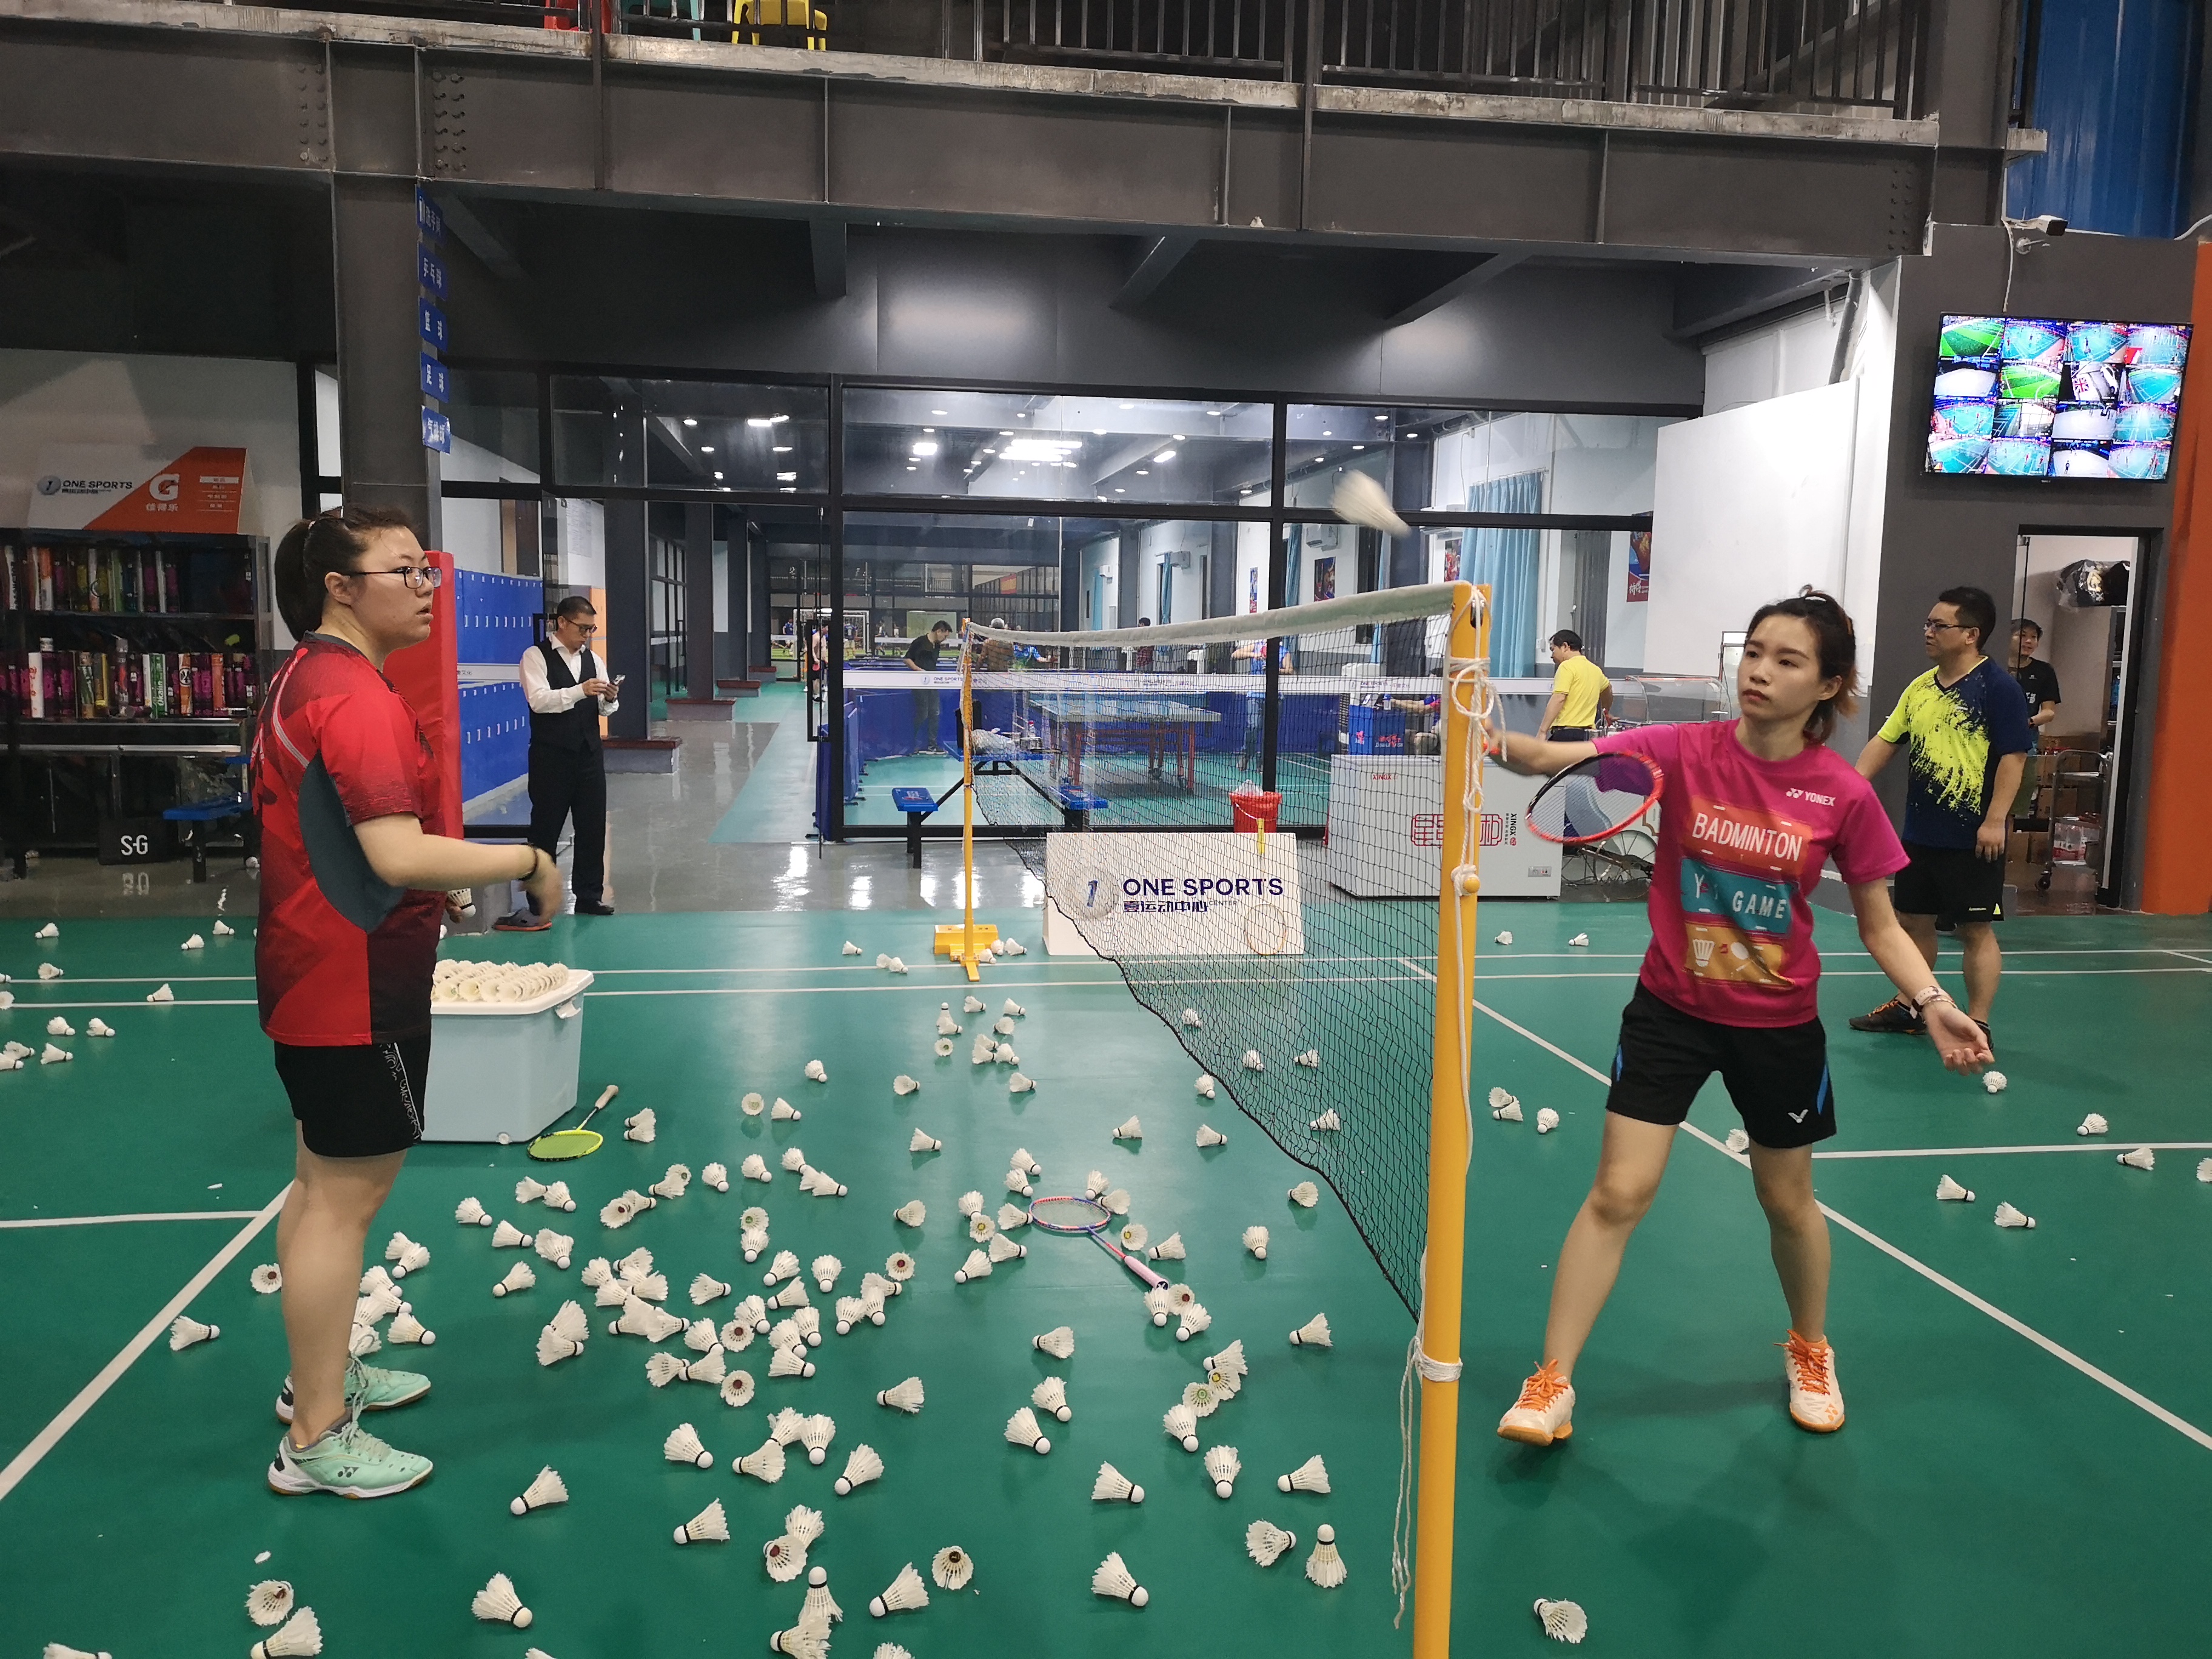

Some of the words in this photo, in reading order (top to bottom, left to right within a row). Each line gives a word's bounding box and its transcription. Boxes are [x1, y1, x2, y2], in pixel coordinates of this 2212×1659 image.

[423, 257, 442, 289] 乒乓球
[426, 364, 444, 394] 足球
[89, 481, 133, 489] SPORTS
[1804, 790, 1836, 808] YONEX
[1692, 812, 1803, 862] BADMINTON
[1123, 879, 1175, 896] ONE
[1183, 879, 1284, 896] SPORTS
[1732, 890, 1787, 919] GAME
